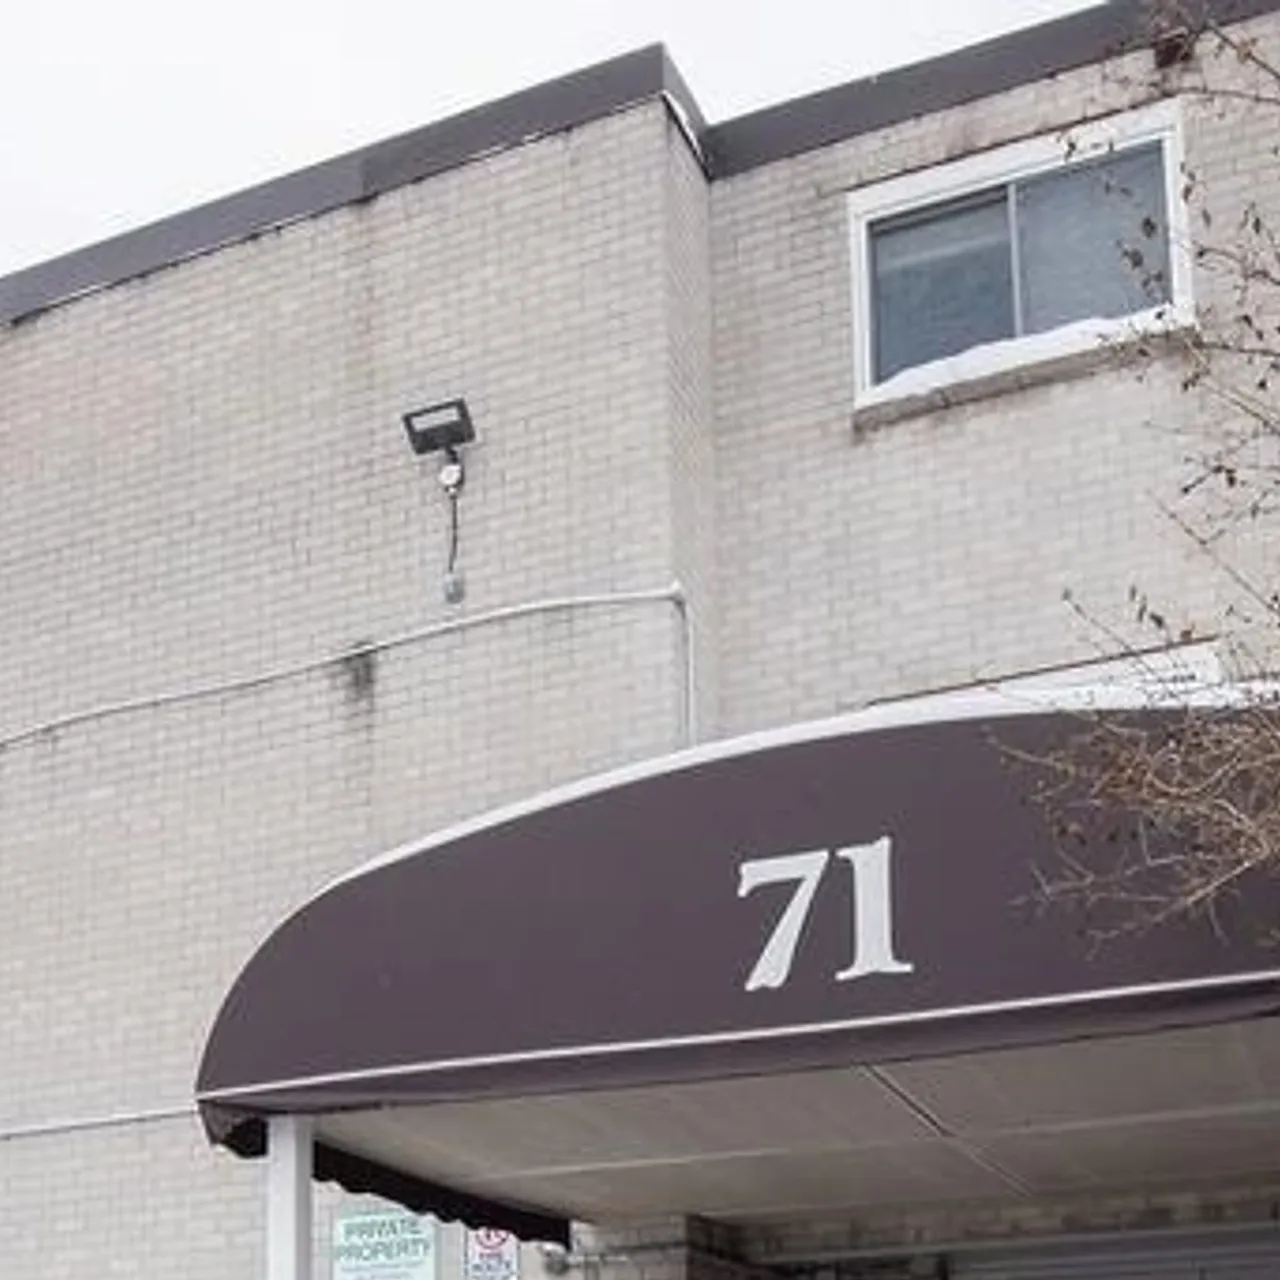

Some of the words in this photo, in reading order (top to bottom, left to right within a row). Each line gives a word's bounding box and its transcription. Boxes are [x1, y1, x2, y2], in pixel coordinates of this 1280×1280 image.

[737, 836, 914, 991] 71
[343, 1217, 422, 1241] PRIVATE
[338, 1238, 430, 1261] PROPERTY
